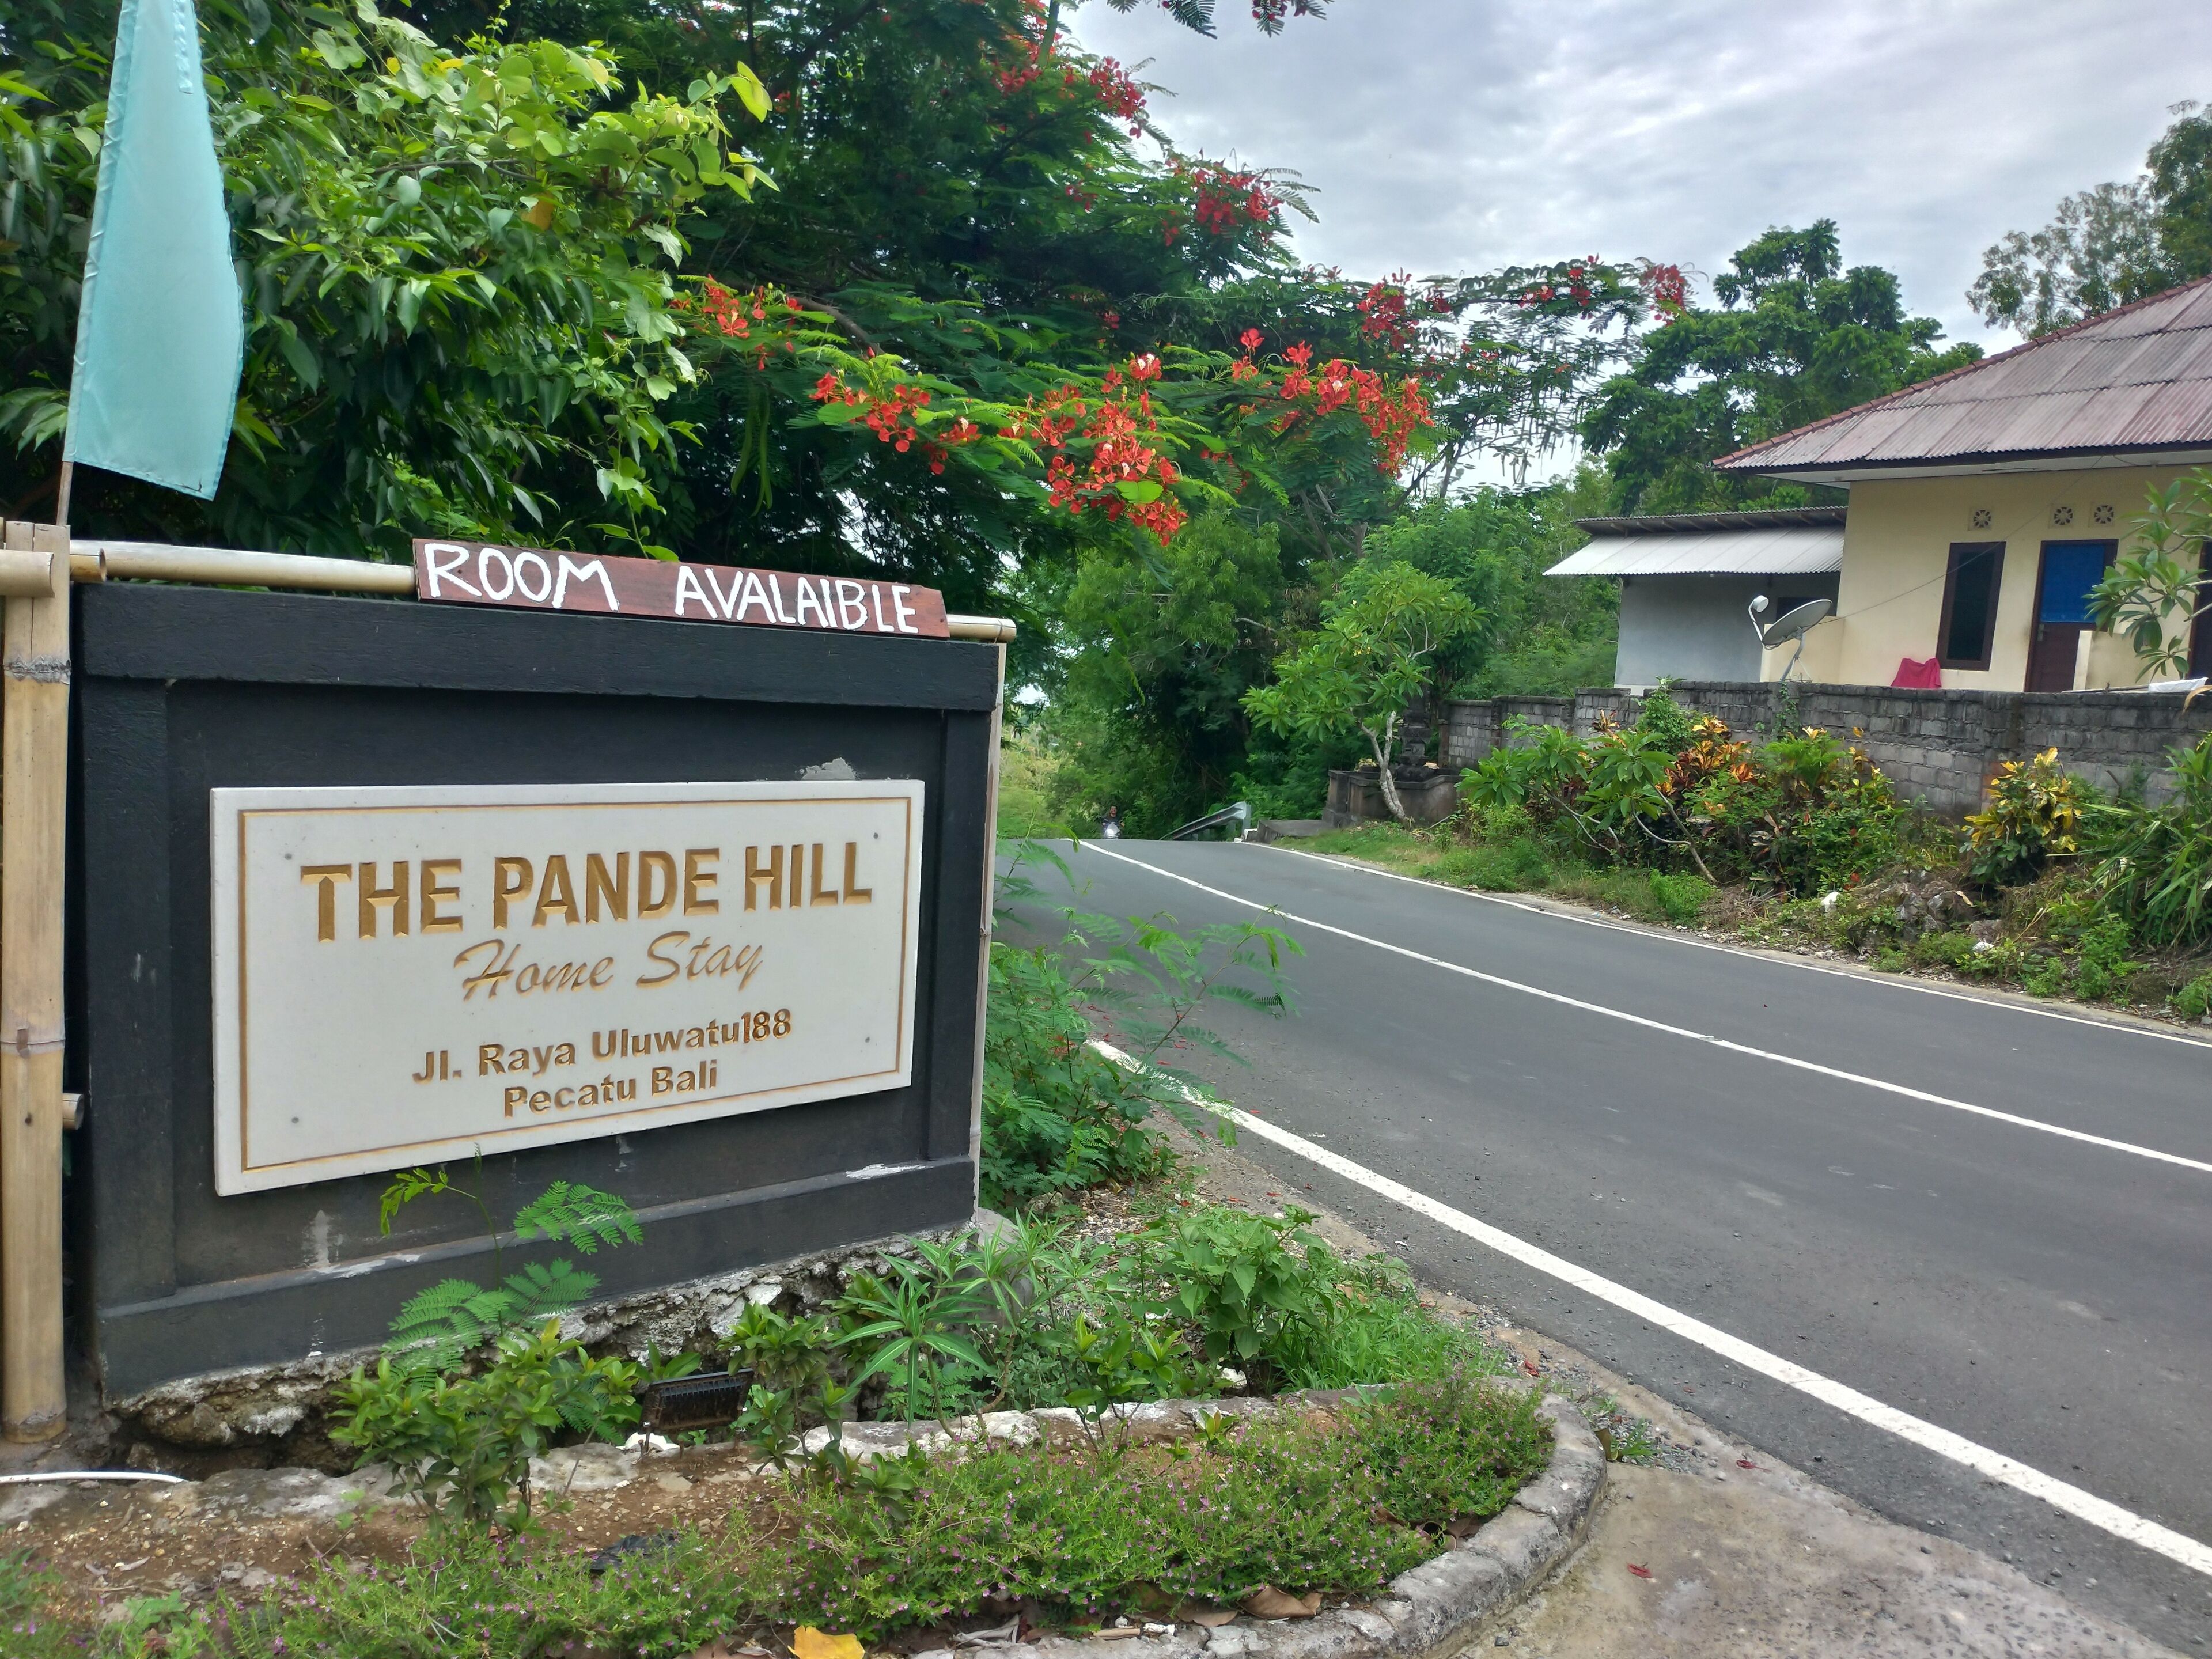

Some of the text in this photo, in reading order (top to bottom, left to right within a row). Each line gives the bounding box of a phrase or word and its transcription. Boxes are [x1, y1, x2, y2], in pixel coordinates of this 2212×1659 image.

[424, 543, 919, 633] ROOM AVALAIBLE
[300, 842, 873, 942] THE PANDE HILL
[454, 931, 763, 1000] Home Stay
[479, 1041, 577, 1078] Raya
[503, 1060, 718, 1118] Pecatu Bali
